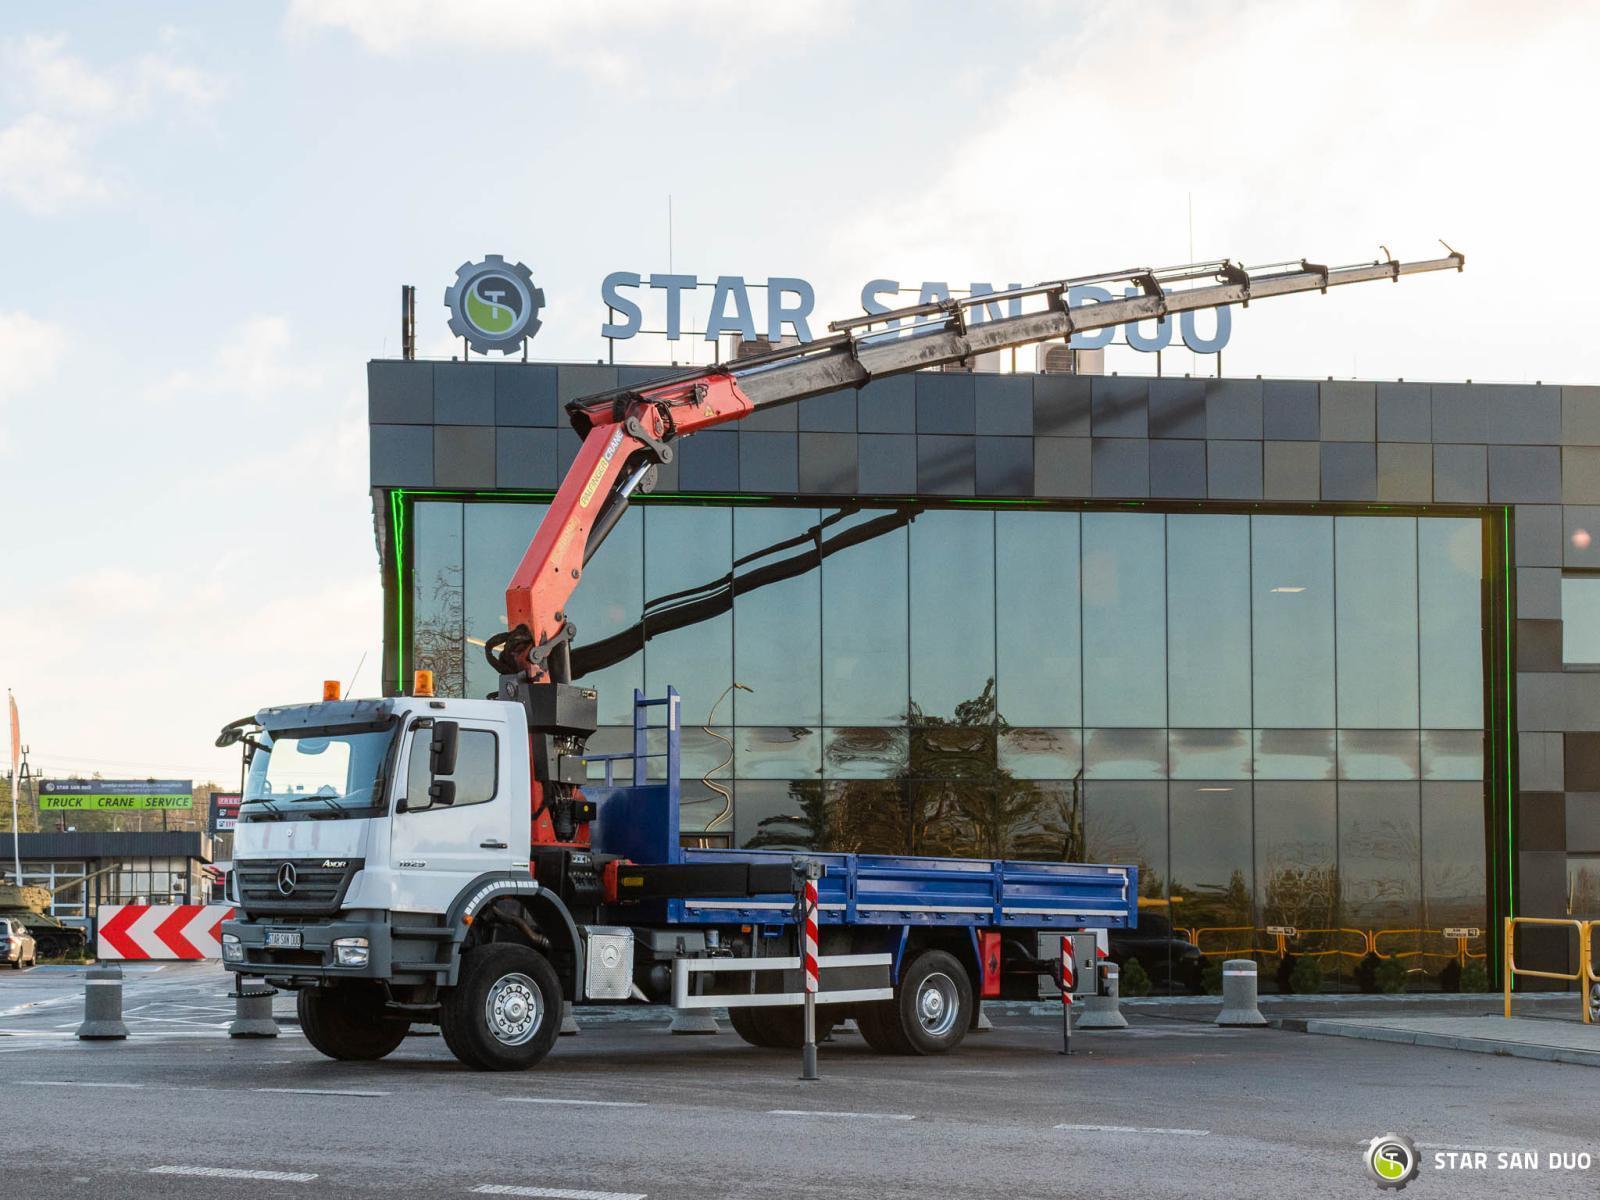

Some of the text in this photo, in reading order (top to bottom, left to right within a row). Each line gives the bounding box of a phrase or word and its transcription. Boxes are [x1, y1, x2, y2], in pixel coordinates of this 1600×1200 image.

[601, 271, 1232, 354] STAR SAN DUO
[47, 797, 190, 807] TRUCK CRANE SERVICE
